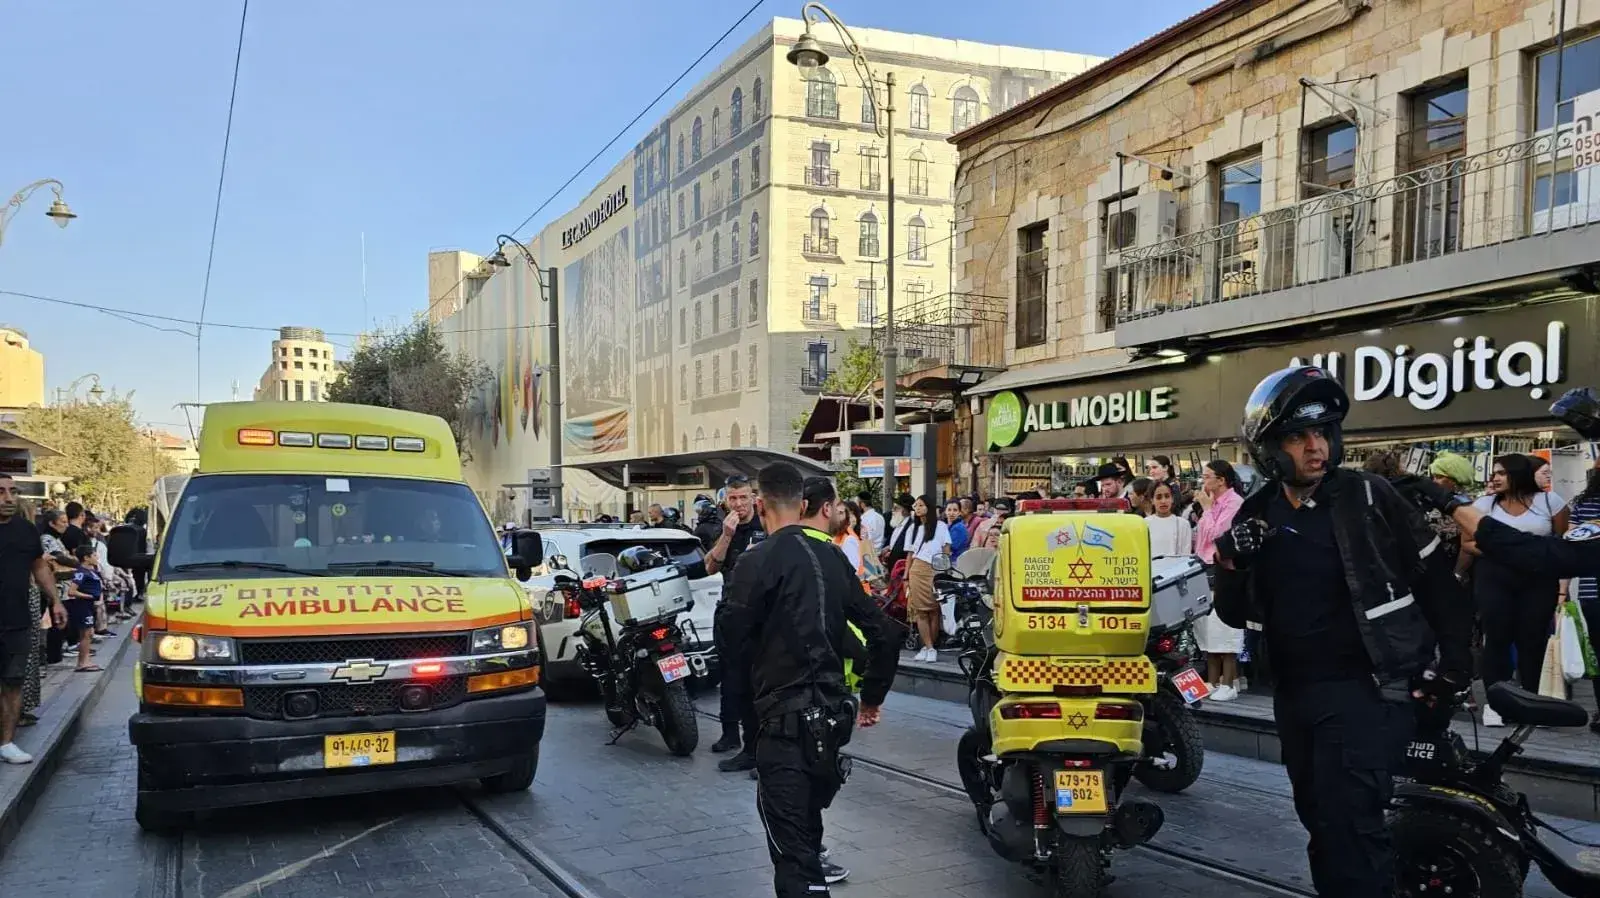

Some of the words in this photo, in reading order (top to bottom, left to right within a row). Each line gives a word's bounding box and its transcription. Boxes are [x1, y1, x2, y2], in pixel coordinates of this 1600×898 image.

[572, 207, 600, 244] GRAND
[1353, 320, 1564, 411] Digital
[1023, 400, 1065, 433] ALL
[1070, 387, 1174, 428] MOBILE
[1024, 556, 1054, 564] MAGEN
[1103, 556, 1119, 566] דוד
[1122, 556, 1139, 566] מגן
[1113, 567, 1139, 576] אדום
[1099, 576, 1139, 586] בישראל
[237, 586, 320, 600] אדום
[336, 584, 394, 596] דוד
[411, 585, 463, 598] מגן
[1024, 587, 1064, 599] הלאומי
[1068, 587, 1106, 599] ההצלה
[1110, 588, 1140, 600] ארגון
[170, 594, 223, 612] 1522
[238, 597, 466, 618] AMBULANCE
[1028, 615, 1067, 630] 5134
[1098, 616, 1128, 630] 101
[1406, 749, 1434, 760] LICE
[1072, 788, 1093, 800] 602
